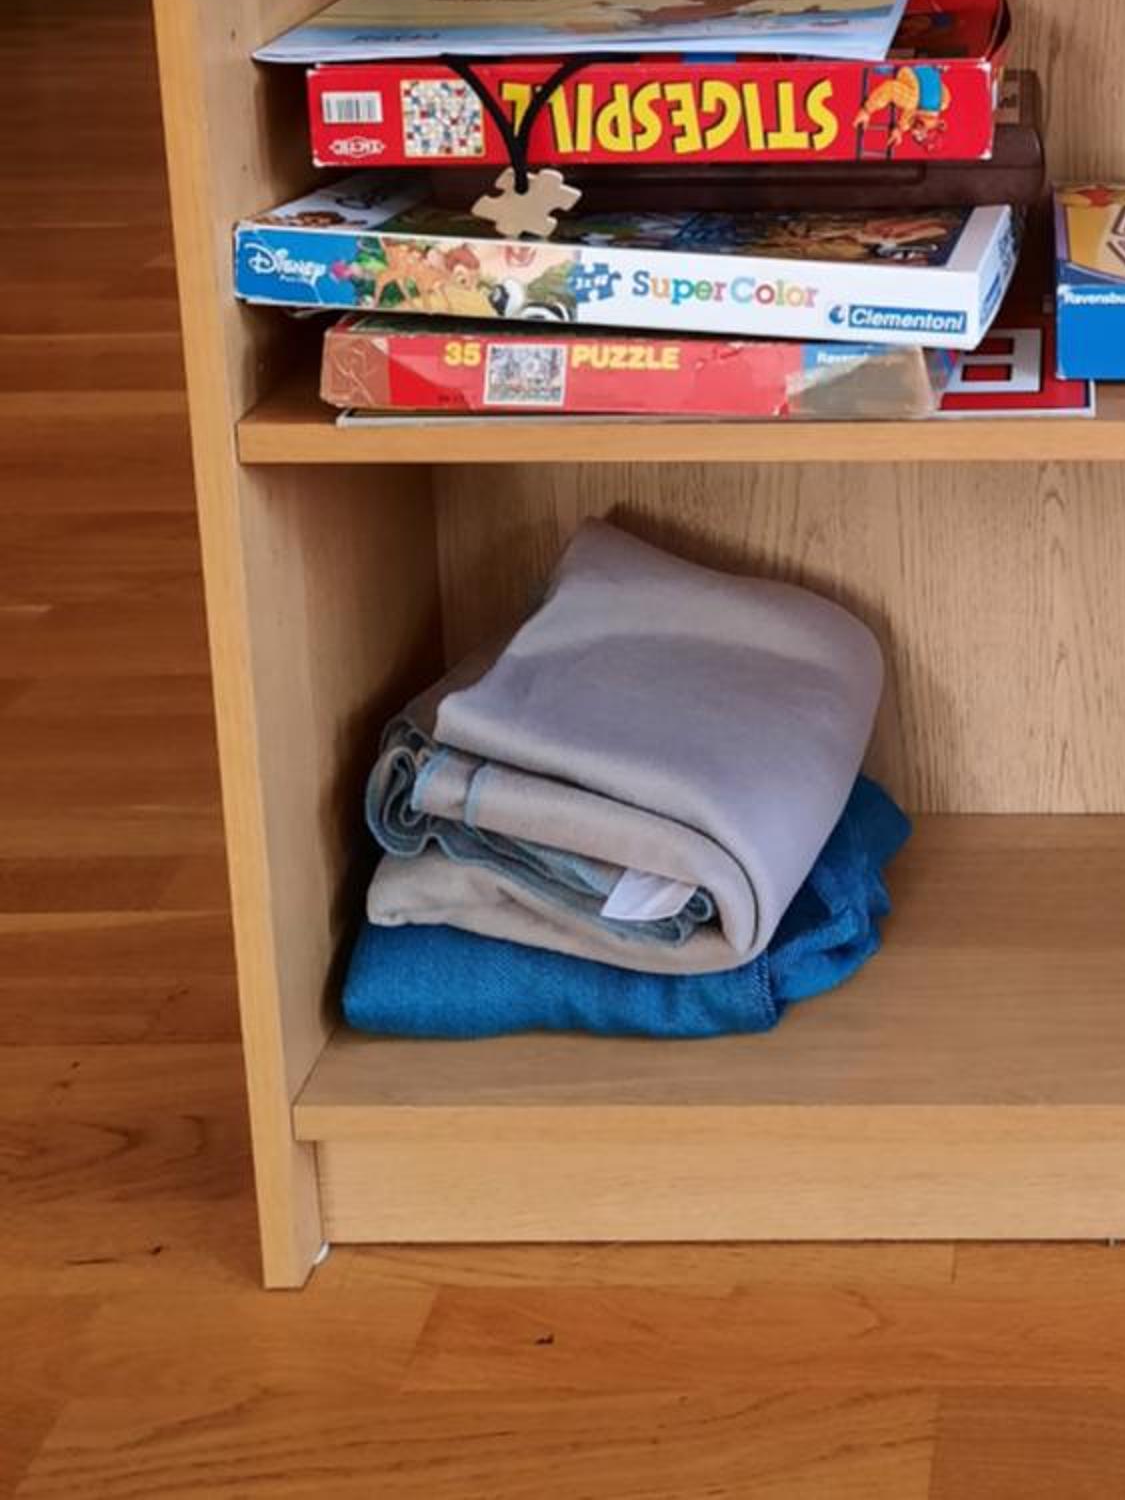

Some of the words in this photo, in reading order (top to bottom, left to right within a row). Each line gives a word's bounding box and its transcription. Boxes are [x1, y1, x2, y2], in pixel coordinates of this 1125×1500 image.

[244, 242, 326, 285] Disney
[852, 307, 964, 332] Clementoni
[445, 342, 481, 366] 35
[571, 344, 679, 370] PUZZLE
